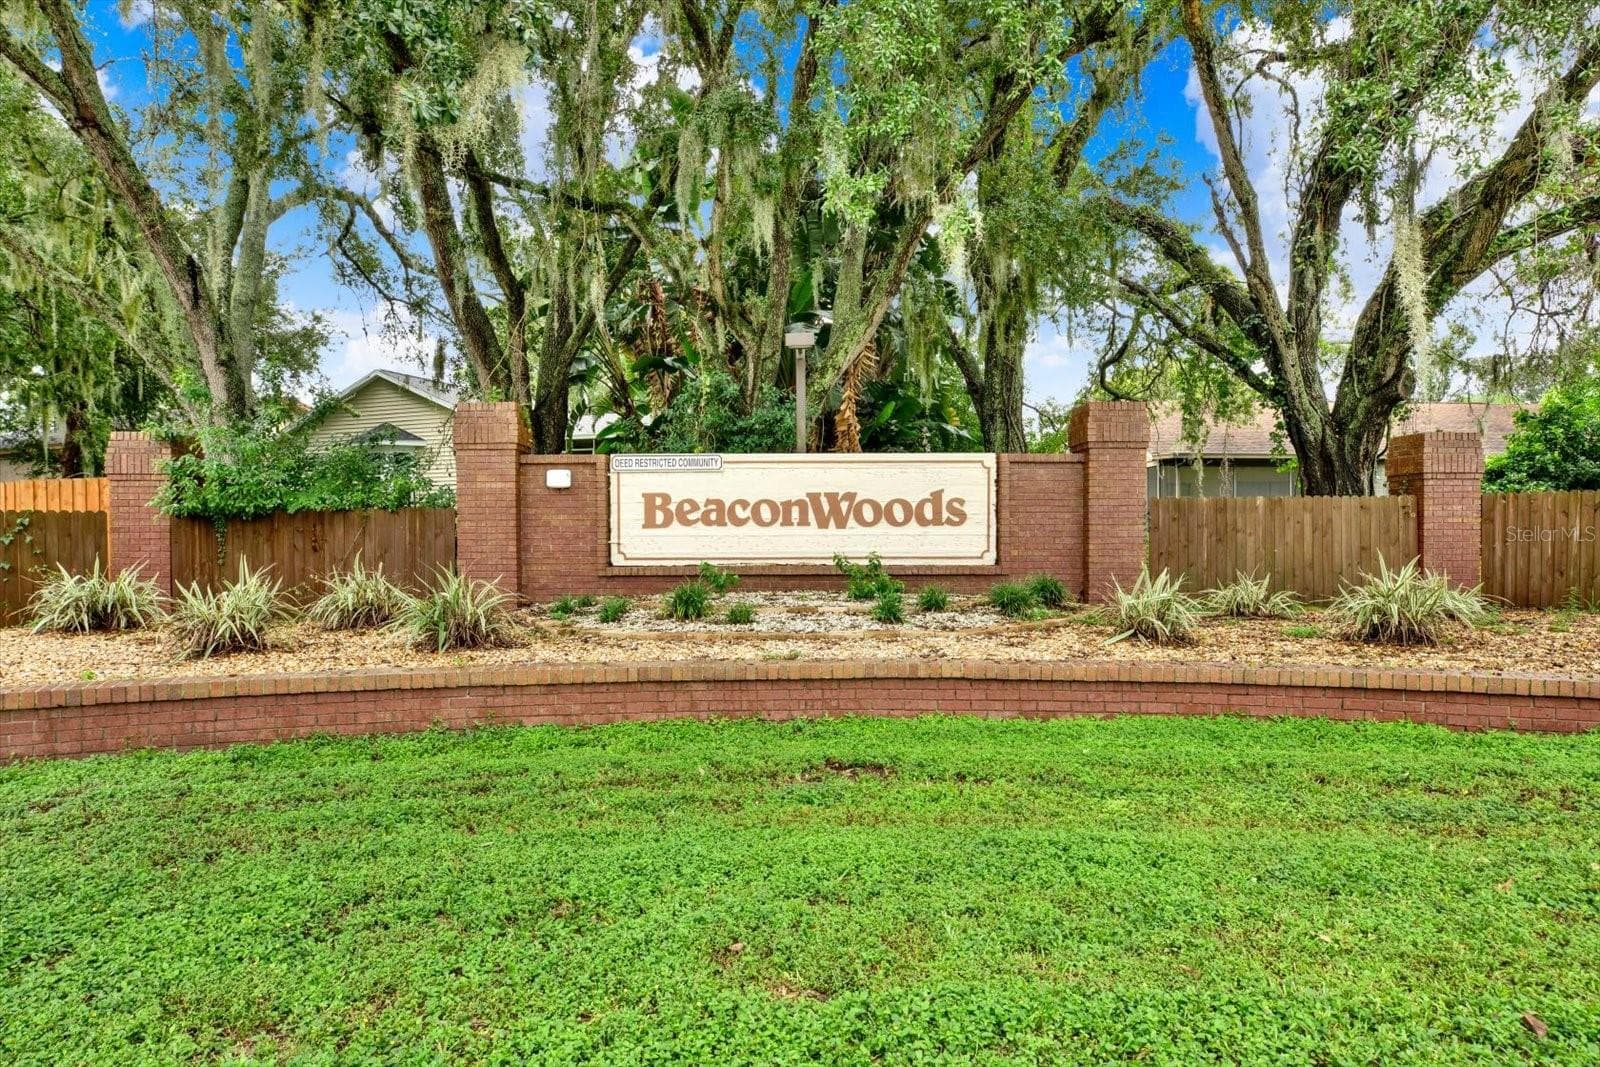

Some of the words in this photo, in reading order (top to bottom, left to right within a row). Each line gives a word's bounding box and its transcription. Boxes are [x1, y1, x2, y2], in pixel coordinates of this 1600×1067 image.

[615, 458, 634, 468] DEED
[635, 458, 677, 468] RESTRICTED
[678, 458, 720, 467] COMMUNITY
[641, 488, 968, 530] BeaconWoods
